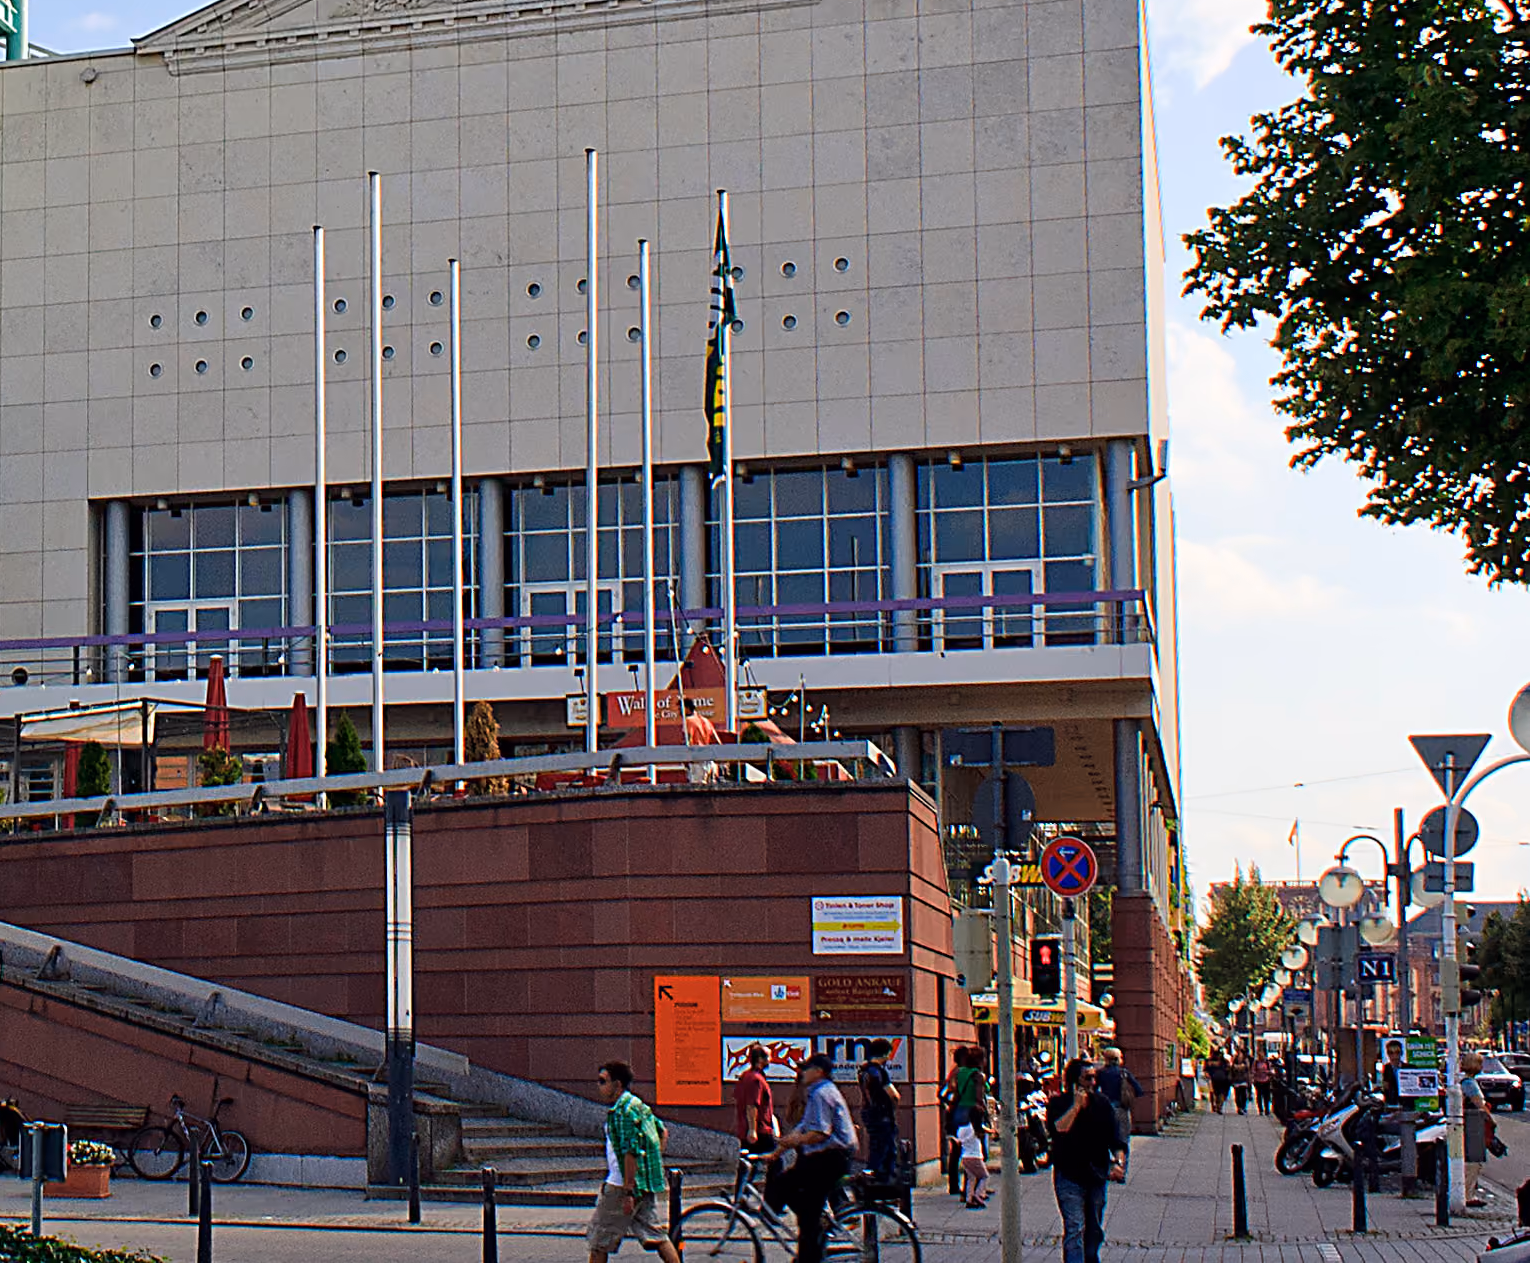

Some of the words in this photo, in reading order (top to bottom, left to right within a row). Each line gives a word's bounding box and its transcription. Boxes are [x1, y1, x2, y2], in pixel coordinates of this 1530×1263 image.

[617, 695, 651, 716] Wal
[656, 696, 672, 709] of
[1361, 960, 1390, 977] N1
[818, 978, 851, 987] GOLD
[856, 978, 901, 987] ANKAUF
